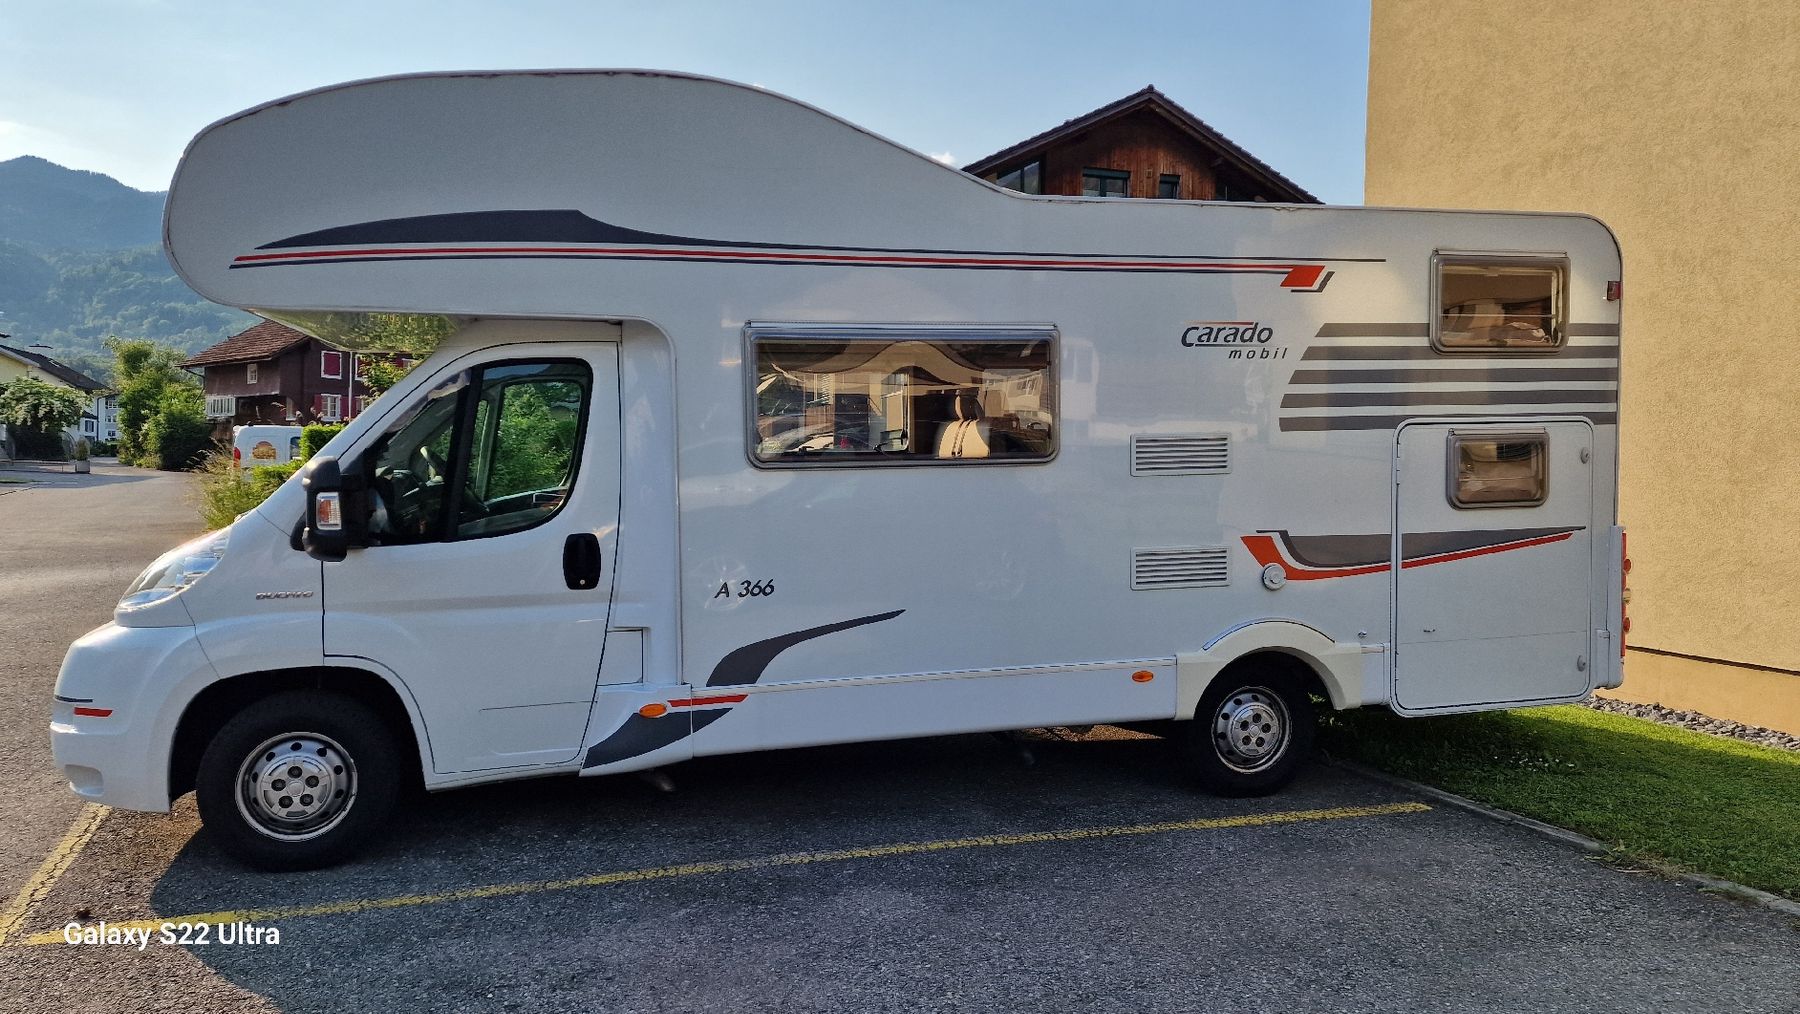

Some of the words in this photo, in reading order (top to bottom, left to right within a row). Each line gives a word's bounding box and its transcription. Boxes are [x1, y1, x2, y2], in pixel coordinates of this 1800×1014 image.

[1228, 347, 1288, 360] mobil
[713, 581, 730, 599] A
[737, 579, 775, 598] 366
